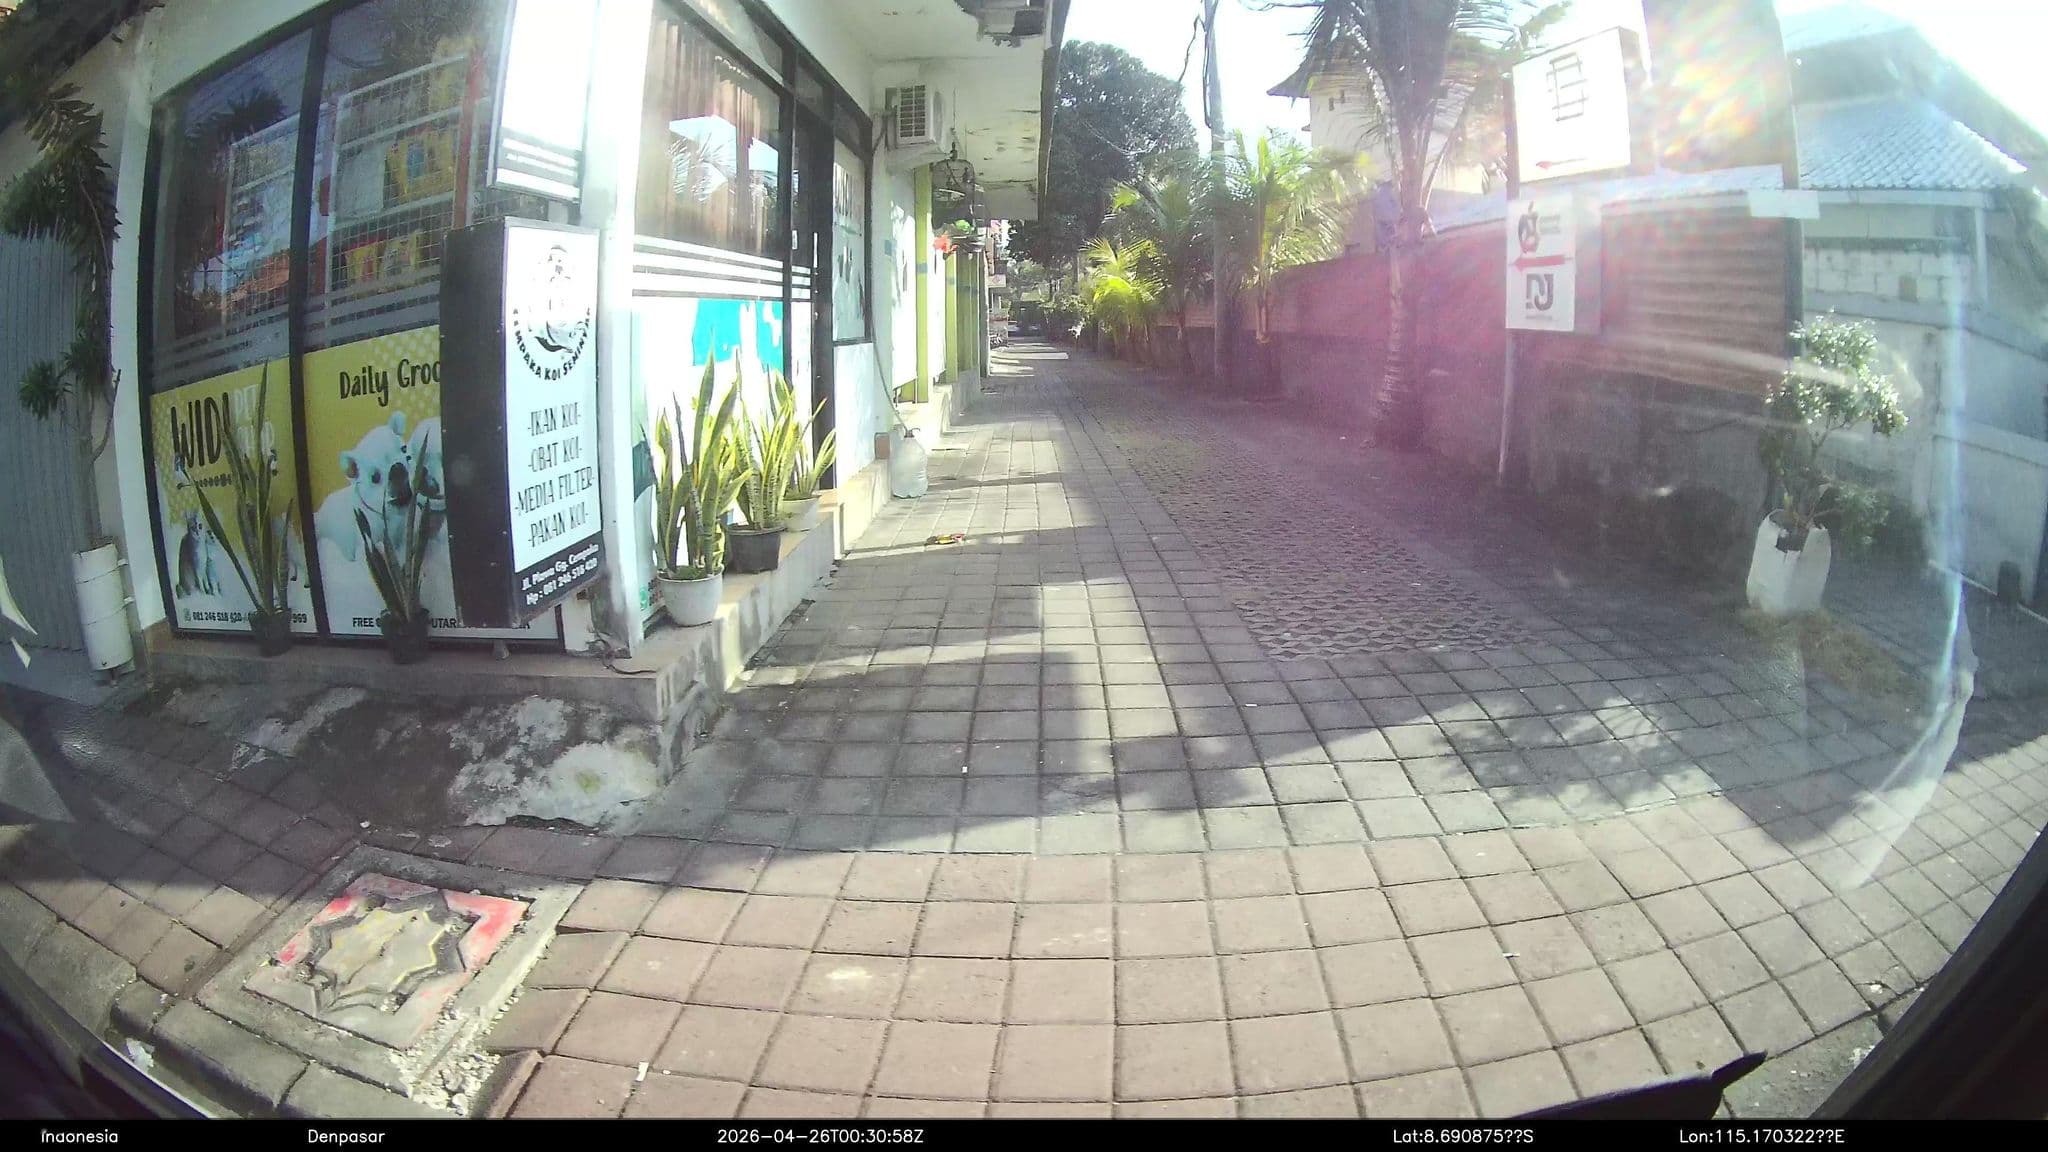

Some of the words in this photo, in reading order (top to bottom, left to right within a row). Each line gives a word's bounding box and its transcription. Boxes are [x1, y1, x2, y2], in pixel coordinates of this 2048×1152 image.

[544, 364, 561, 381] KOI
[340, 365, 389, 407] Daily
[352, 617, 374, 628] FREE
